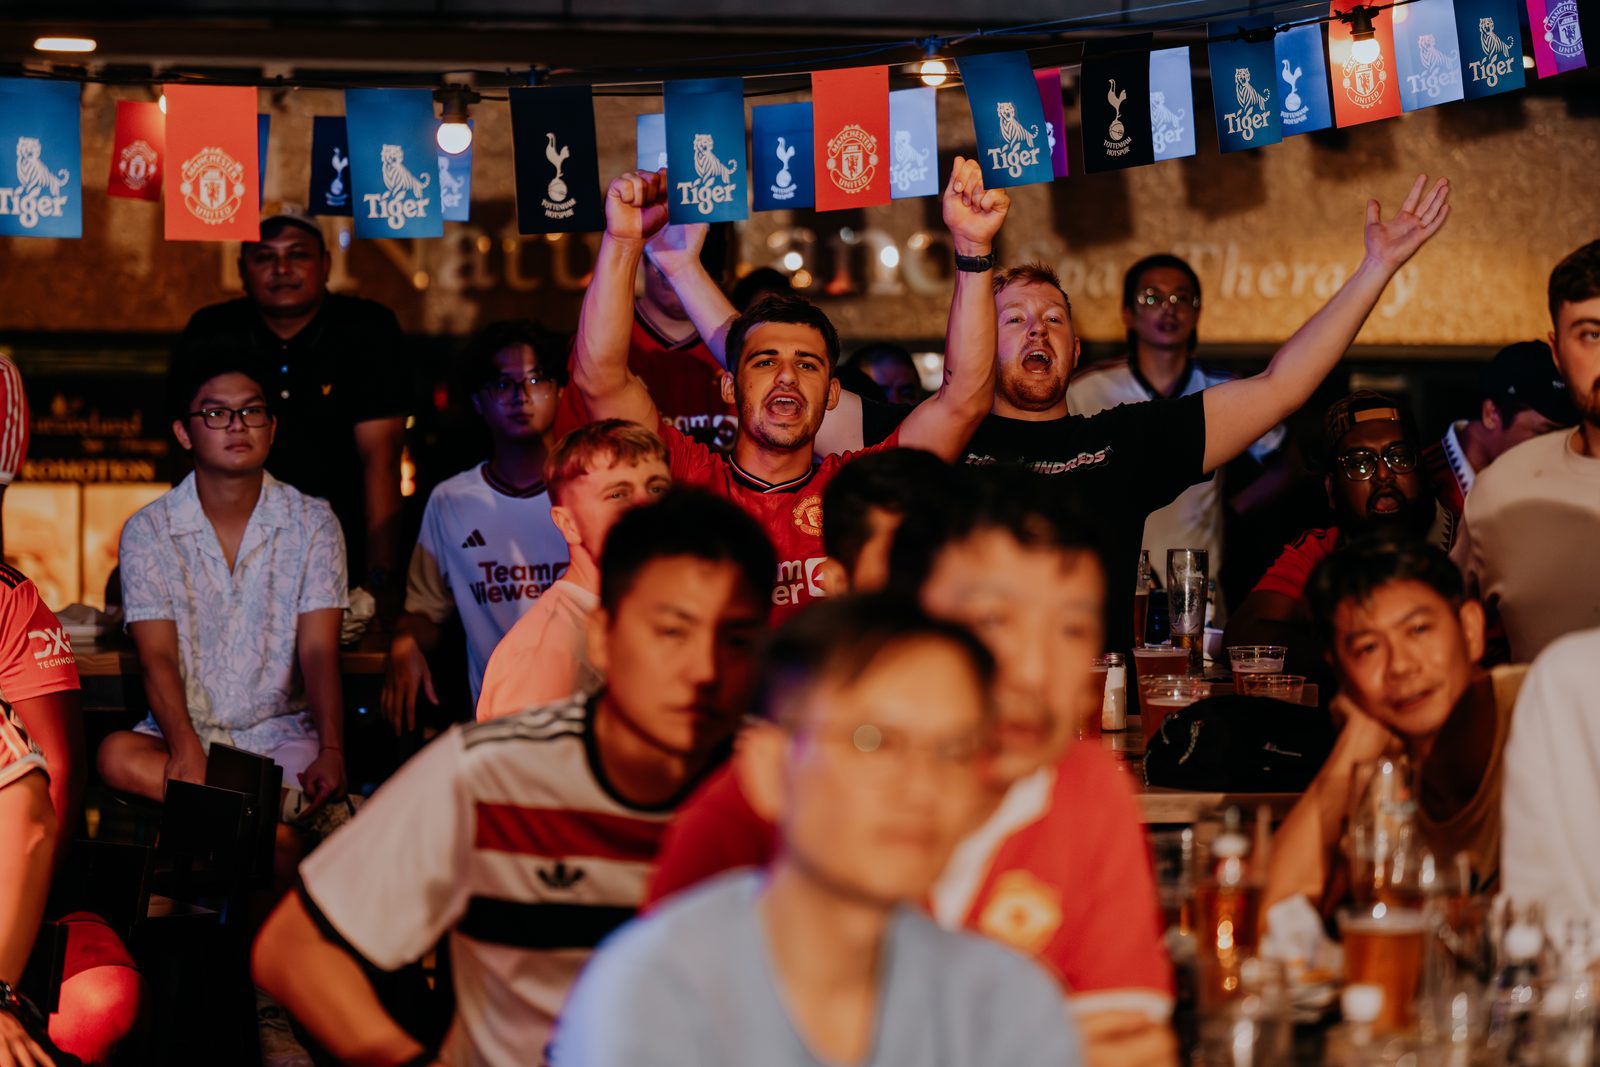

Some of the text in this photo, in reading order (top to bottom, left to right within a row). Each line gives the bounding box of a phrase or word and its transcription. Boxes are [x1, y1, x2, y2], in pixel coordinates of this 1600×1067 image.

[1547, 5, 1577, 28] MANCHES
[1558, 41, 1583, 53] UNITE
[1407, 67, 1459, 97] Tiger
[1468, 55, 1514, 87] Tiger
[1354, 90, 1379, 104] UNITED
[1223, 106, 1271, 141] Tiger
[831, 130, 873, 153] MANCHESTER
[1103, 136, 1132, 150] TOTTENHAM
[1106, 146, 1131, 157] HOTSPUR
[1152, 124, 1184, 153] ger
[187, 154, 238, 178] MANCHESTER
[987, 143, 1040, 178] Tiger
[838, 175, 868, 189] UNITED
[889, 162, 928, 191] iger
[0, 186, 68, 228] Tiger
[677, 177, 736, 215] Tiger
[195, 205, 232, 219] UNITED
[363, 190, 430, 229] Tiger
[1170, 242, 1420, 318] Theray
[478, 561, 551, 583] Team
